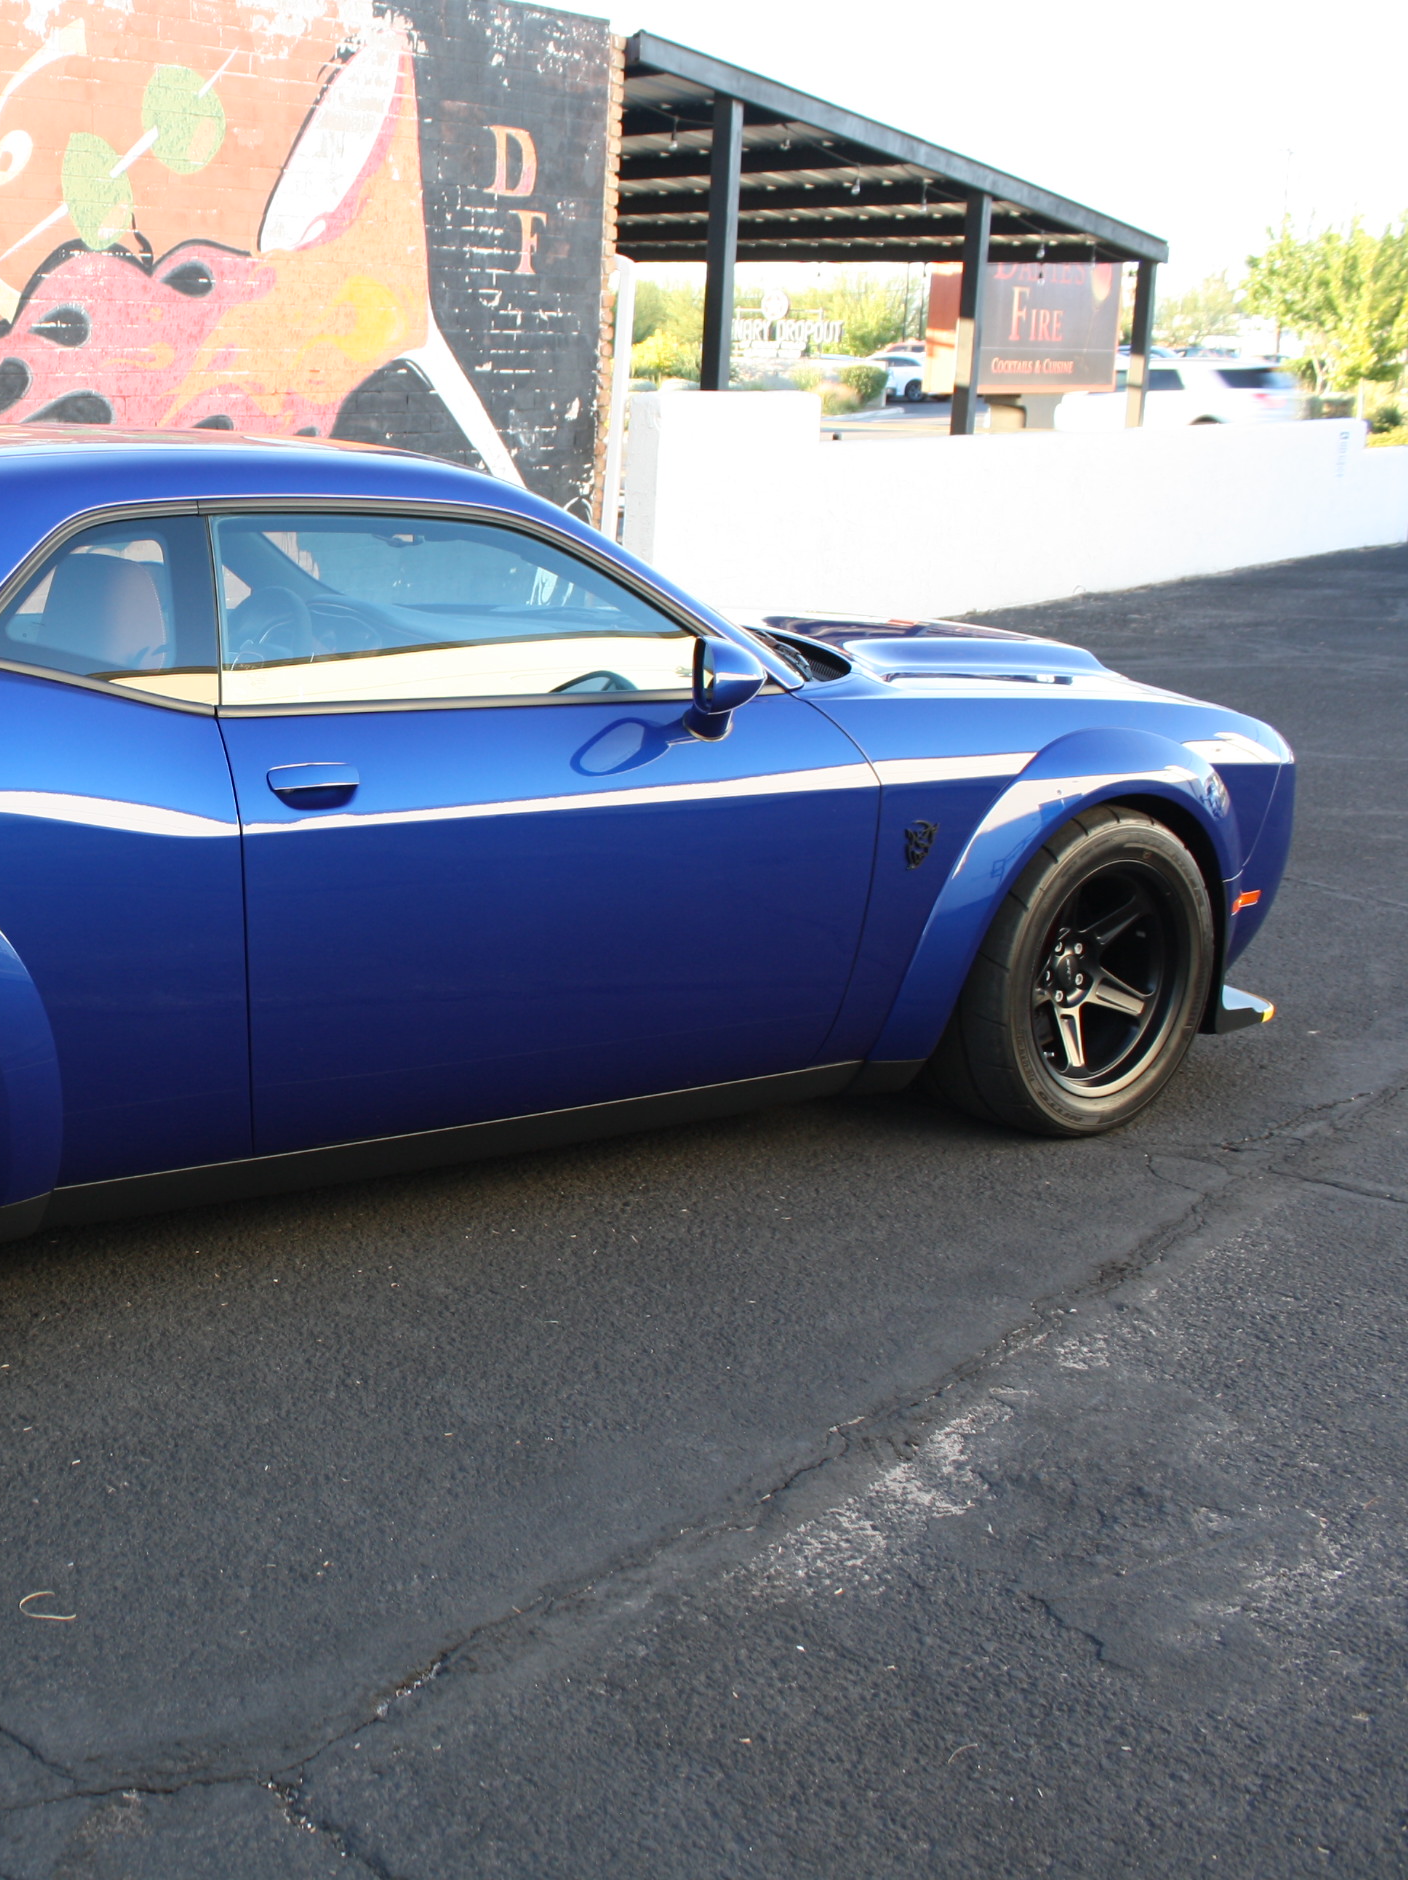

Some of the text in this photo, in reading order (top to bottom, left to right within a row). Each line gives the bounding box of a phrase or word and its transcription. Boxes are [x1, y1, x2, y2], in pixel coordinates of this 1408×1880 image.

[483, 125, 538, 197] D
[509, 210, 547, 275] F
[776, 319, 843, 343] DROPOUT
[1008, 285, 1065, 342] FIRE
[991, 357, 1074, 374] COCKTAILS & CUISINE
